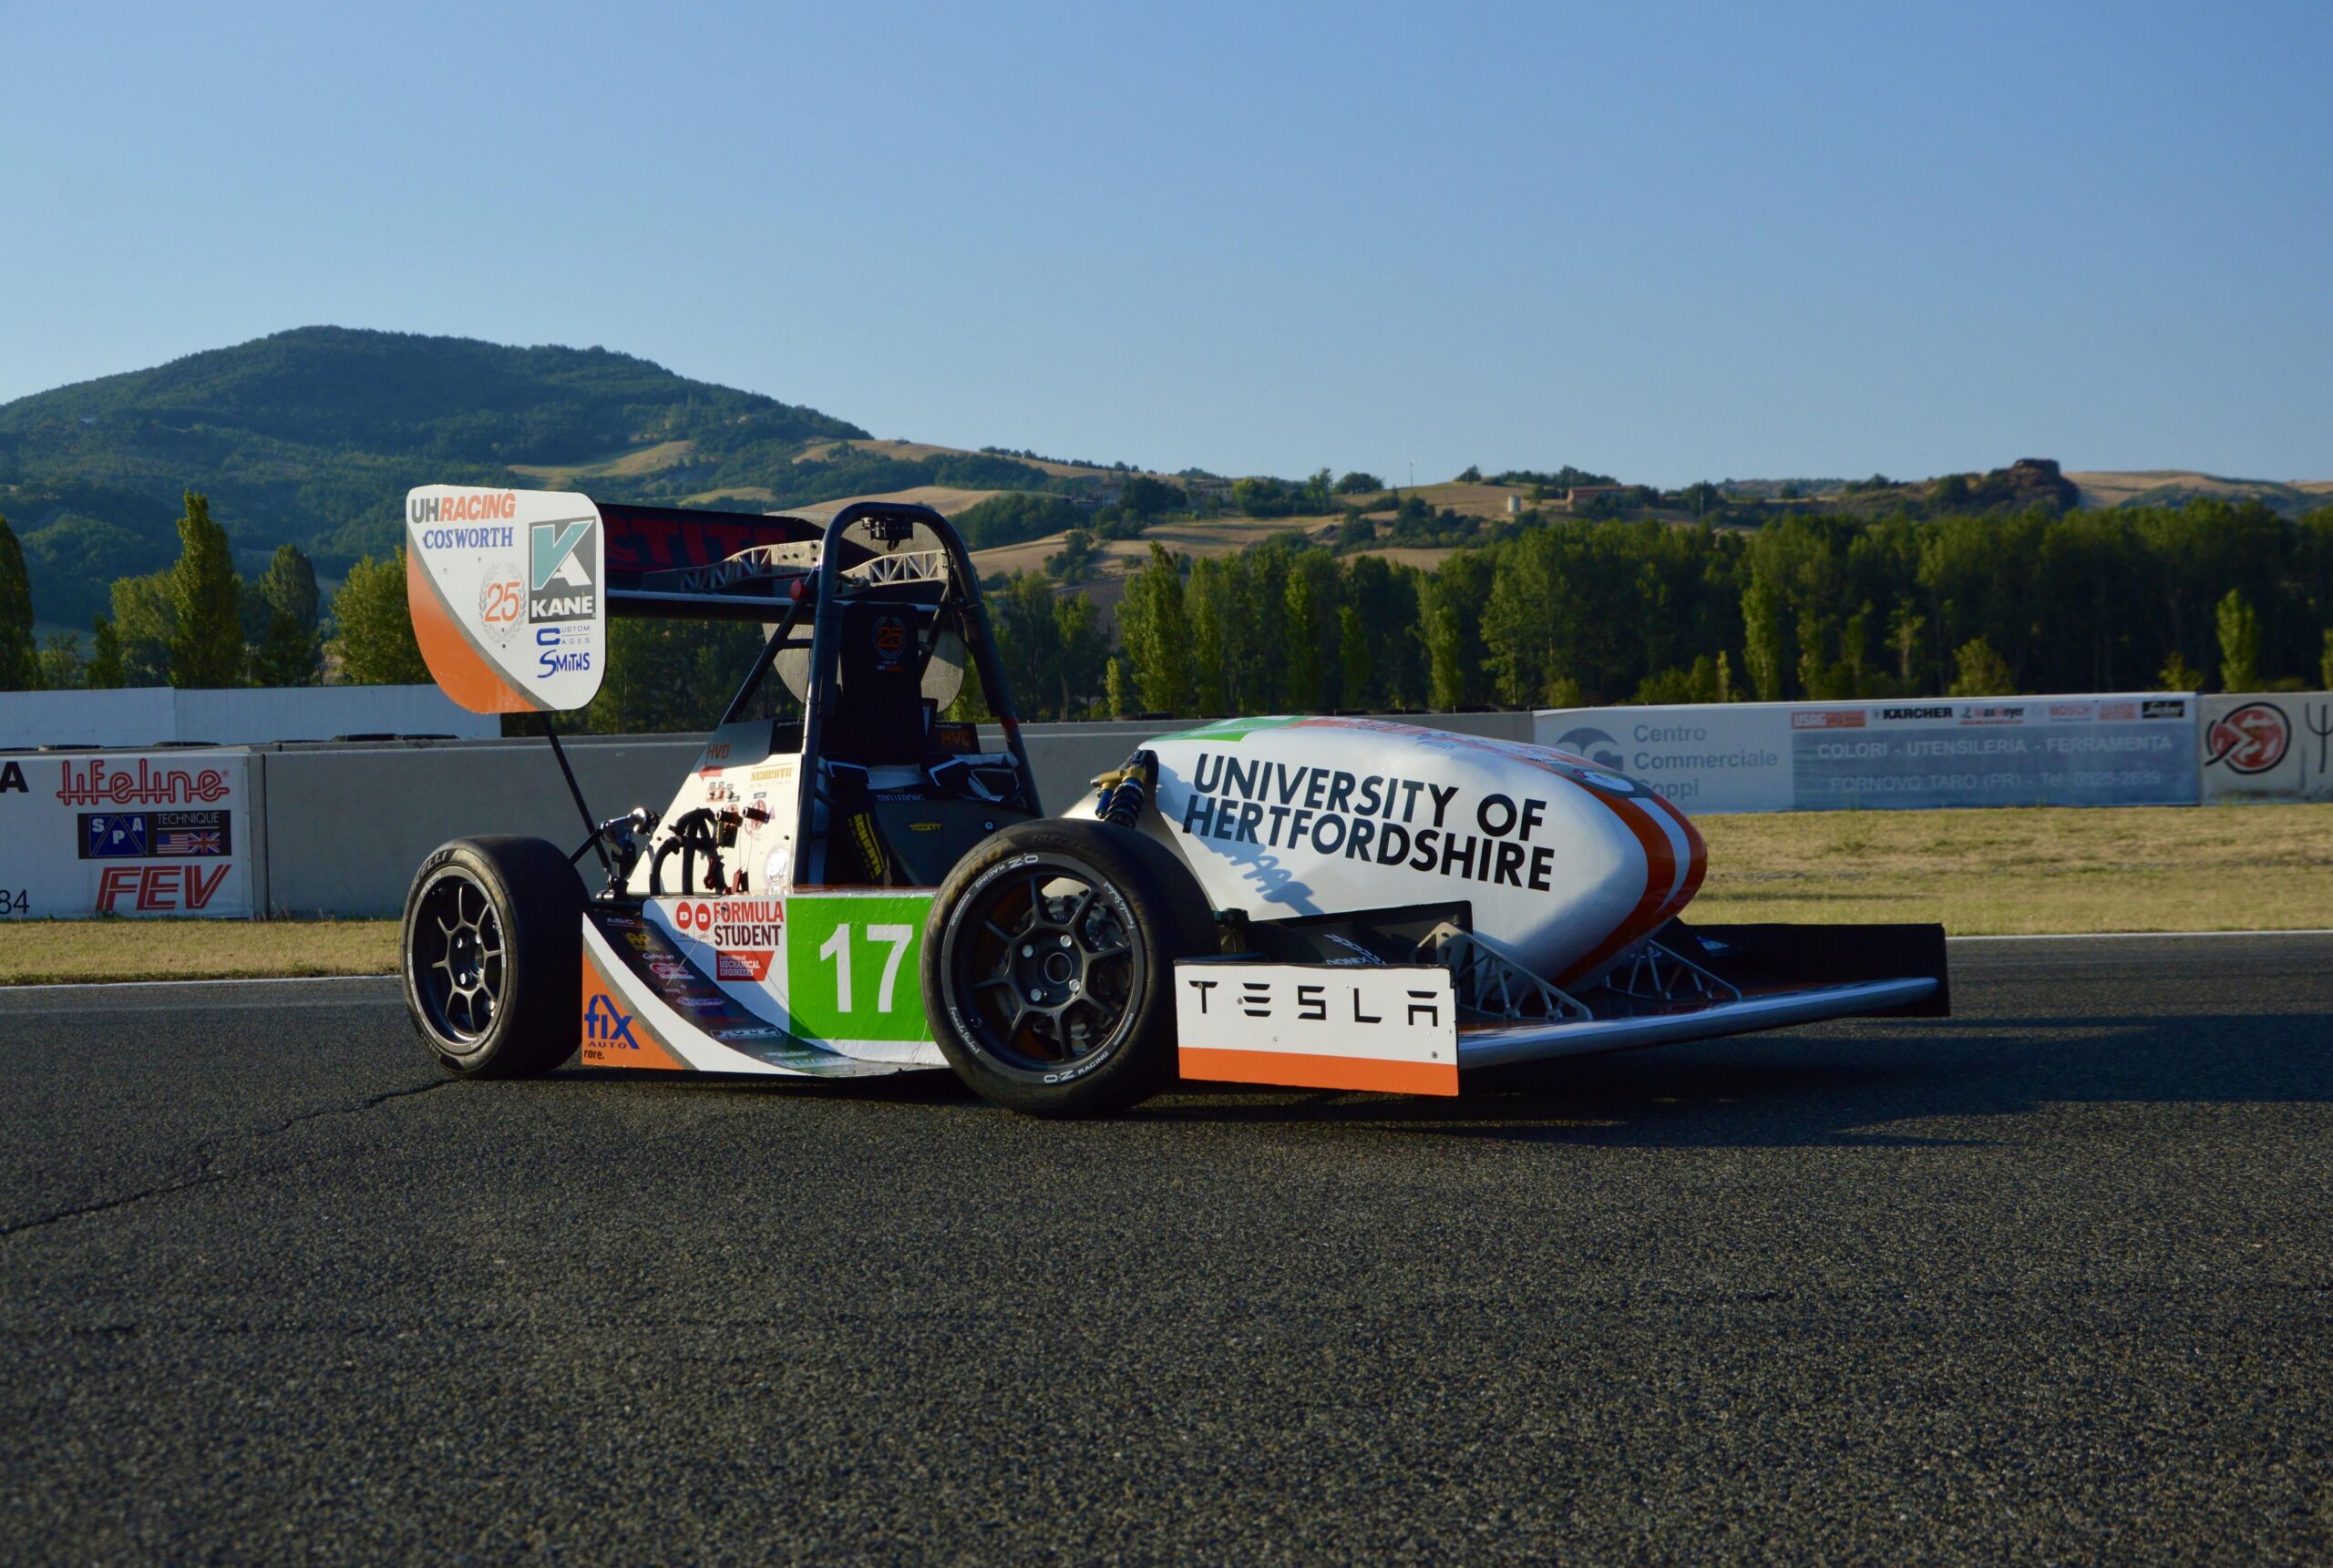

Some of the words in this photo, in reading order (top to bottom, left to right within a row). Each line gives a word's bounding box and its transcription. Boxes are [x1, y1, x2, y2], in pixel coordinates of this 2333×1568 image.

[411, 492, 516, 524] UHRACING
[423, 527, 514, 549] COSWORTH
[484, 581, 520, 622] 25
[531, 595, 594, 618] KANE
[875, 627, 905, 650] 25
[1633, 724, 1707, 743] Centro
[1817, 742, 1887, 759] COLORI
[1906, 739, 2028, 756] UTENSILERIA
[2046, 735, 2174, 753] FERRAMENTA
[1634, 749, 1779, 770] Commerciale
[1830, 774, 1922, 793] FORNOVO
[1928, 774, 1978, 790] TARO
[1193, 753, 1459, 828] UNIVERSITY
[1476, 794, 1547, 842] OF
[157, 812, 220, 825] TECHNIQUE
[1181, 794, 1556, 892] HERTFORDSHIRE
[96, 864, 231, 911] FEV
[713, 901, 785, 923] FORMULA
[714, 925, 782, 947] STUDENT
[719, 960, 760, 968] MECHANICAL
[820, 923, 914, 1013] 17
[1187, 979, 1440, 1029] TESLA
[588, 1041, 627, 1050] AUTO
